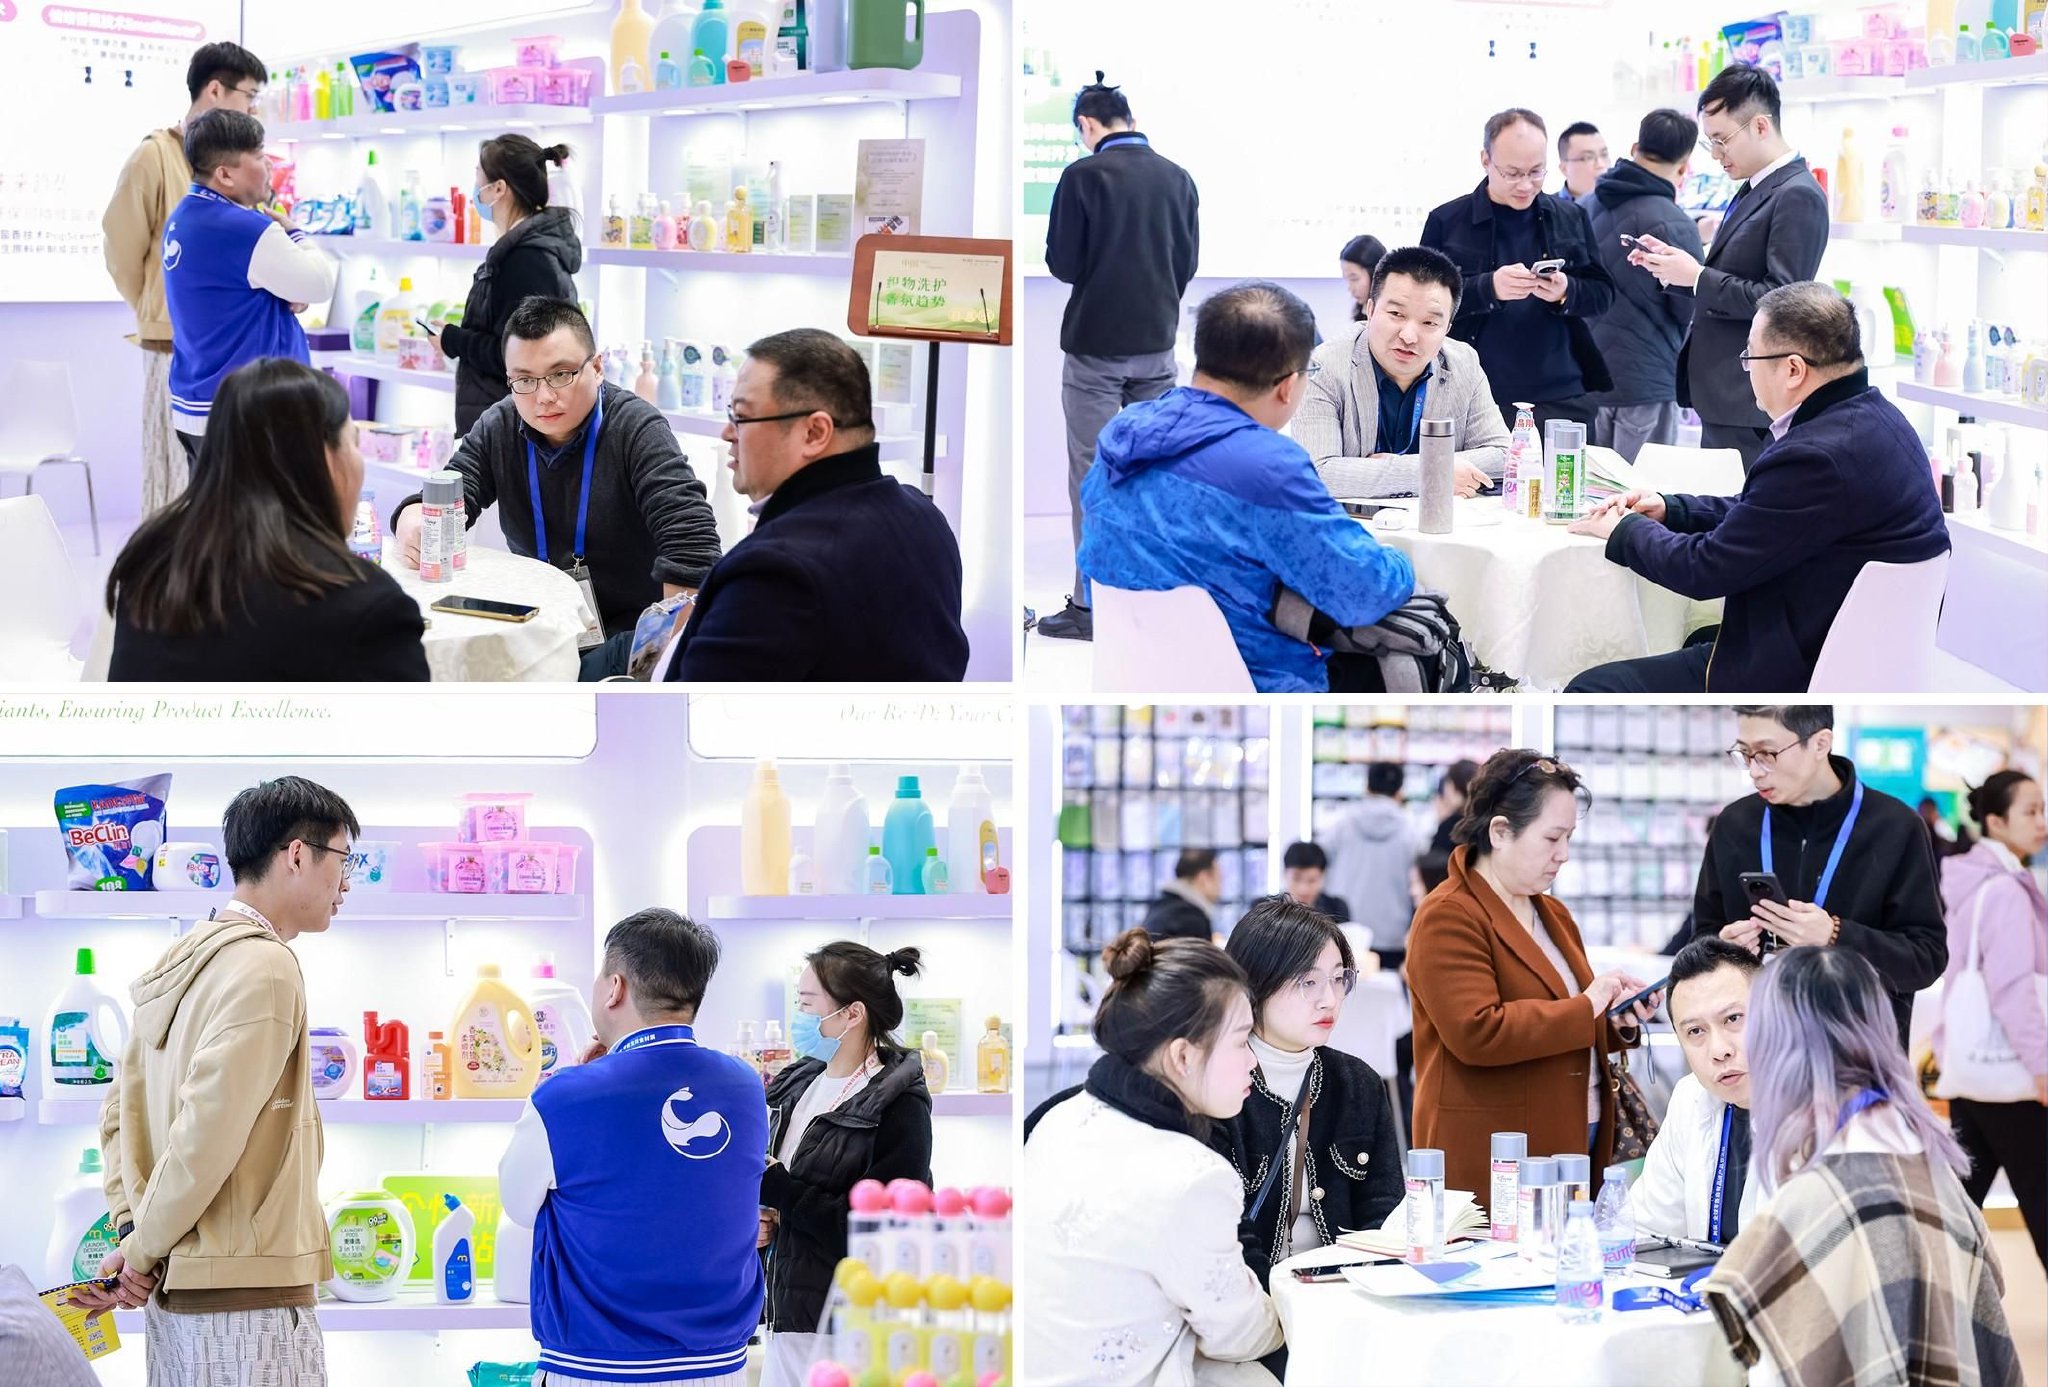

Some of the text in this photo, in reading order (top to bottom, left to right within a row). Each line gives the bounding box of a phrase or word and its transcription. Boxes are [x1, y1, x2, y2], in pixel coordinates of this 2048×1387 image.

[58, 699, 146, 724] Ensuring
[152, 699, 223, 718] Product
[231, 699, 332, 718] Excellence.
[69, 824, 128, 847] BeClin
